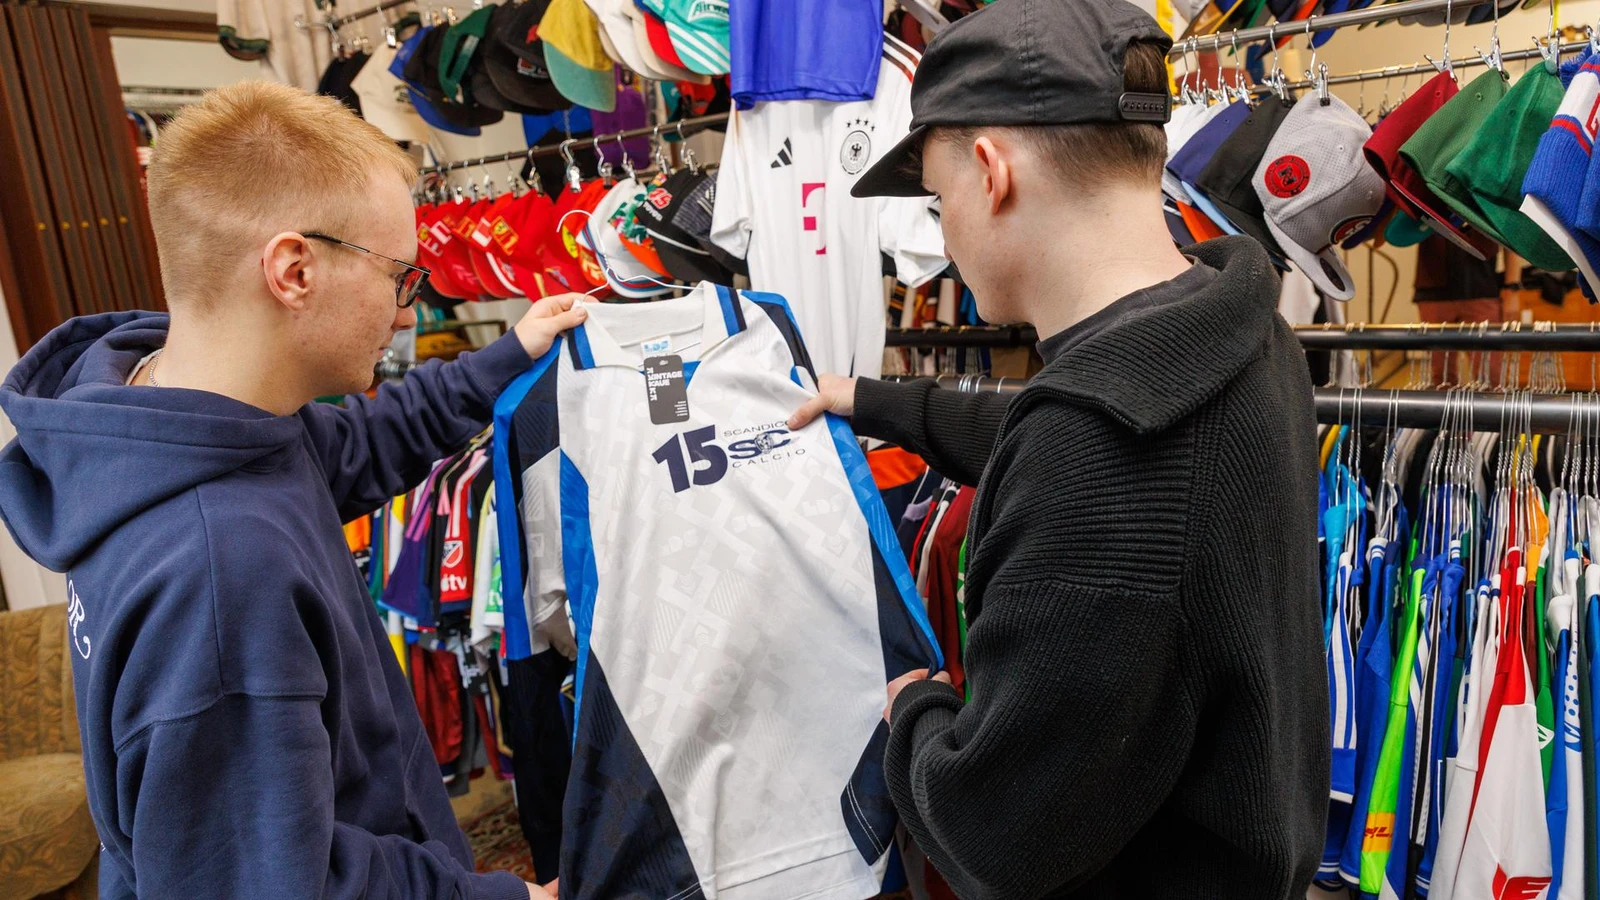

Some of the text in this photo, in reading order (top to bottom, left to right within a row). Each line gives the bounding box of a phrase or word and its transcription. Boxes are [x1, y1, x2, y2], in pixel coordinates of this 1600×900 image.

[652, 424, 729, 493] 15
[728, 429, 791, 459] SC
[732, 448, 806, 468] CALCIO
